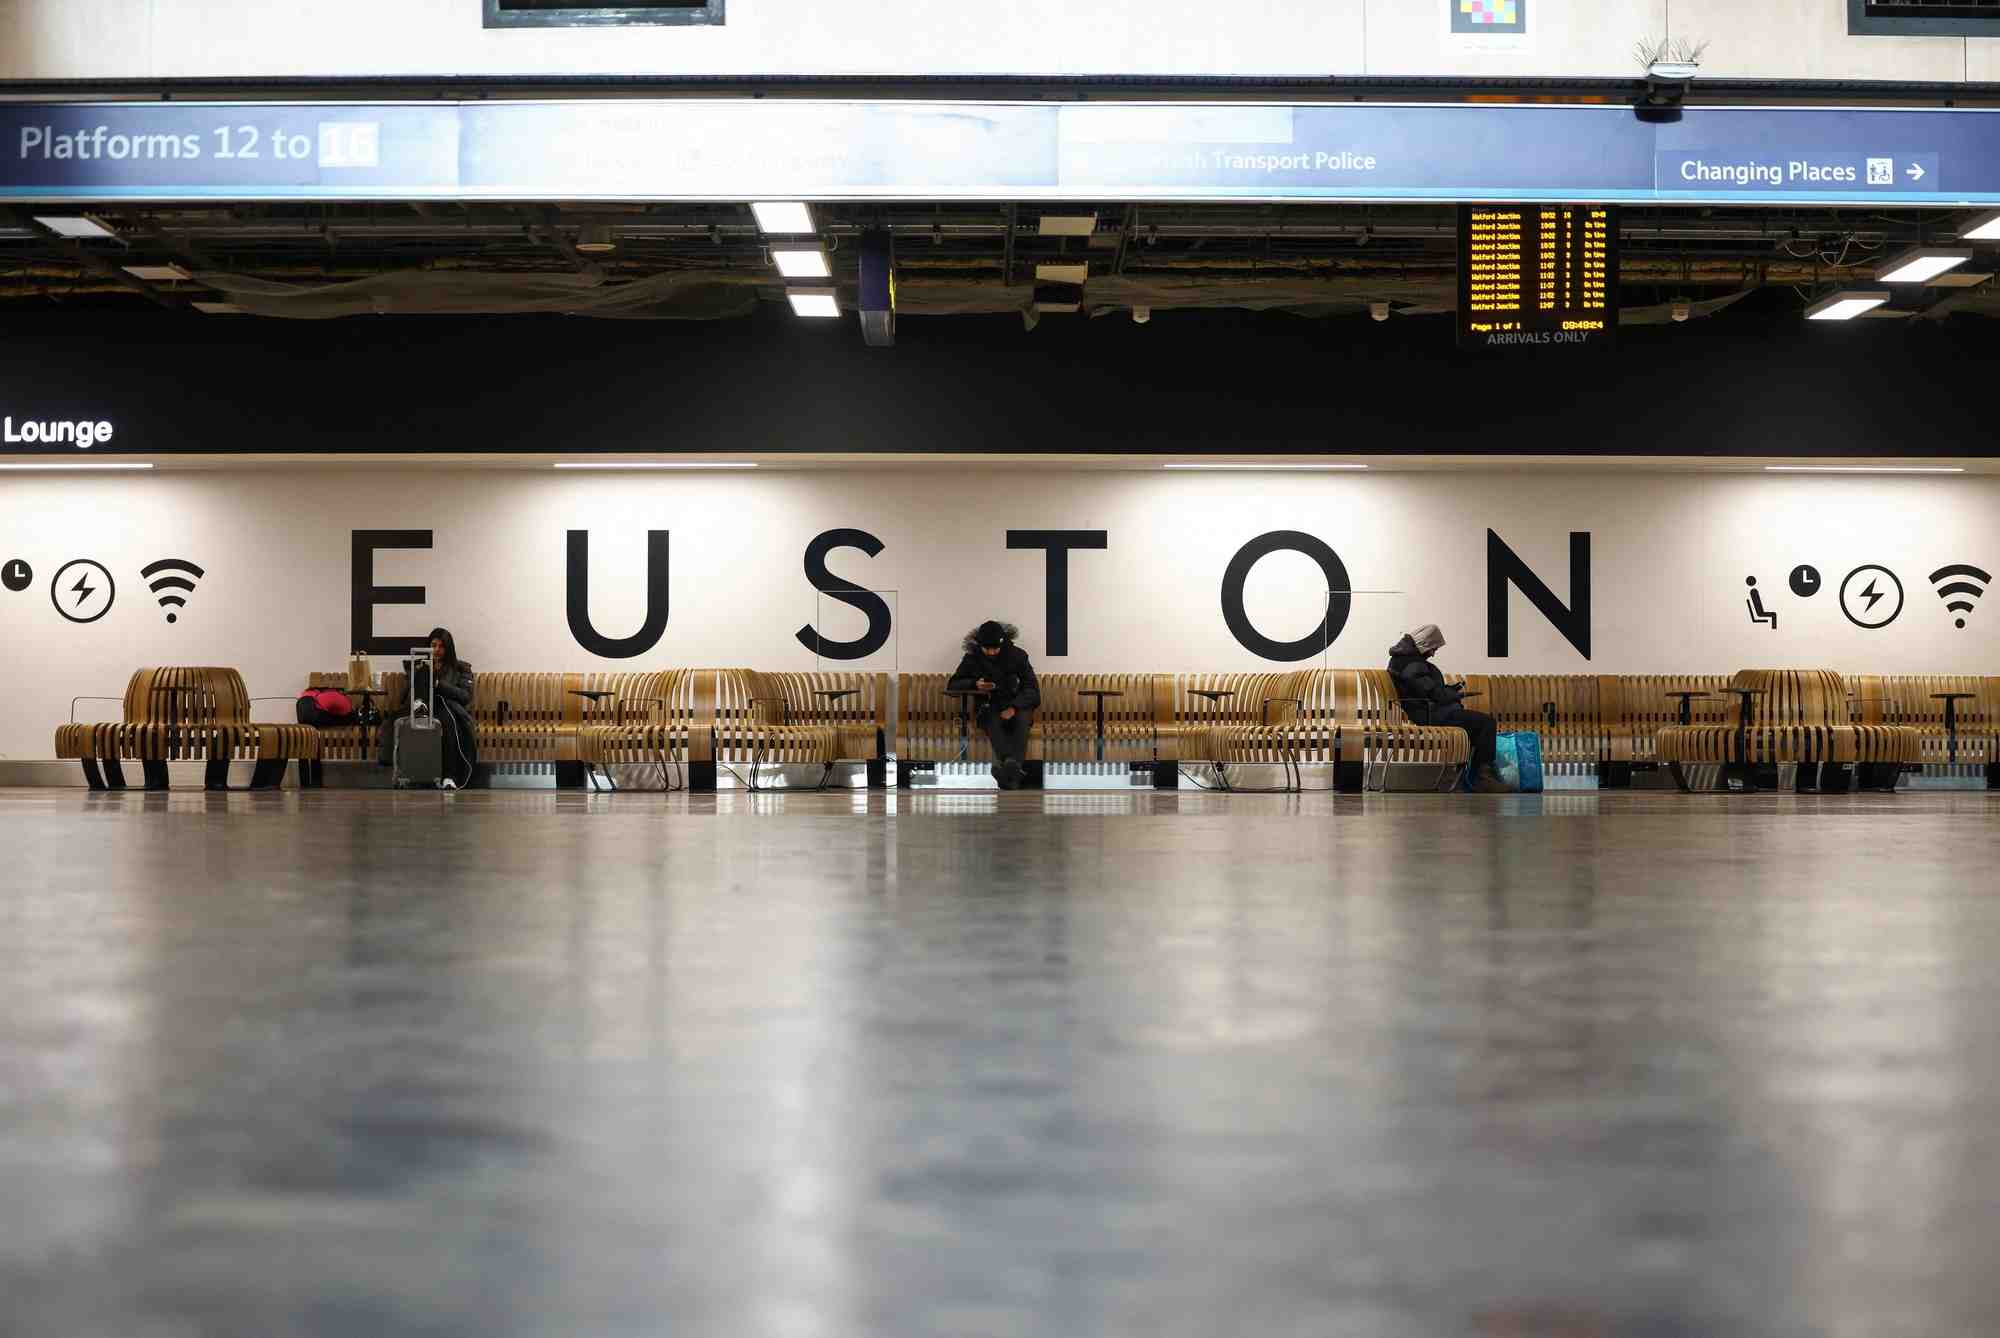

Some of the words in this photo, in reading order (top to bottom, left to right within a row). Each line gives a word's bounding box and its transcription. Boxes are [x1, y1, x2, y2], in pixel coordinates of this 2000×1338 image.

[19, 126, 201, 160] Platforms
[213, 126, 259, 159] 12
[272, 129, 311, 159] to
[1213, 151, 1311, 172] Transport
[1315, 151, 1377, 170] Police
[1680, 159, 1783, 186] Changing
[1788, 160, 1856, 182] Places
[1471, 323, 1492, 331] Page
[1503, 322, 1512, 330] of
[1562, 320, 1604, 330] 09:49:24
[1487, 332, 1550, 345] ARRIVALS
[1554, 331, 1589, 343] ONLY
[3, 416, 114, 448] Lounge
[350, 527, 1593, 661] EUSTON
